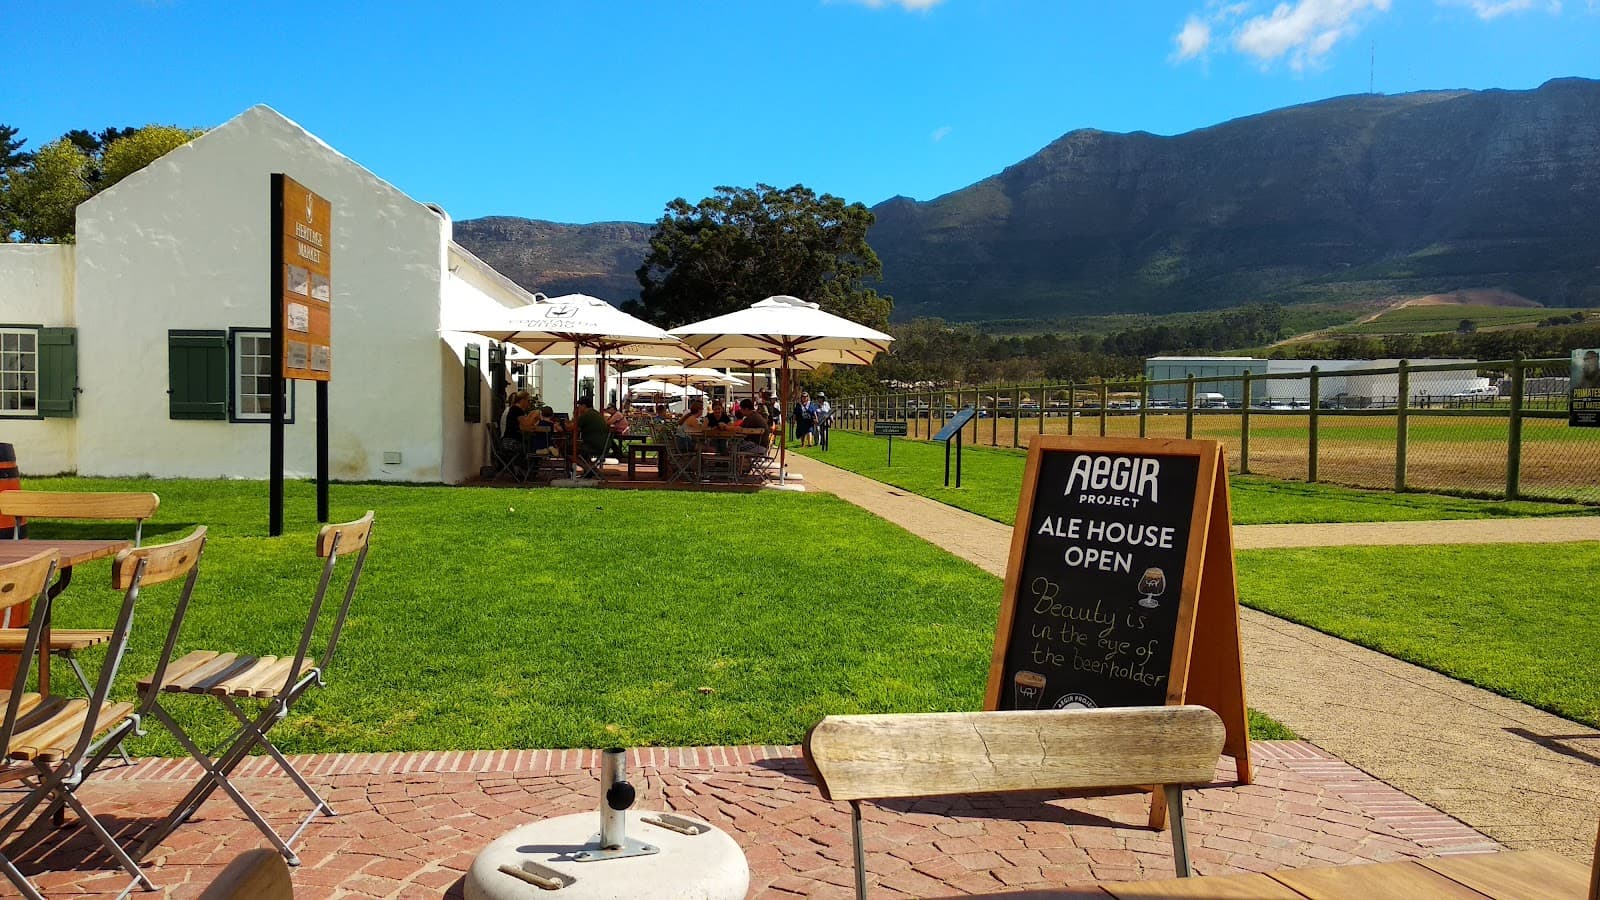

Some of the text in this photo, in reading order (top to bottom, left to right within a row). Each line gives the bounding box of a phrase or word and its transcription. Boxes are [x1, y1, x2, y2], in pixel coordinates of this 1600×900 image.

[295, 221, 322, 247] HERITAGE
[298, 241, 320, 263] MARKET
[1079, 494, 1140, 508] PROJECT
[1038, 516, 1175, 549] ALE HOUSE
[1064, 546, 1133, 574] OPEN
[1031, 576, 1147, 638] Beauty is
[1031, 623, 1159, 666] in the eye of
[1031, 642, 1166, 687] the beerholder
